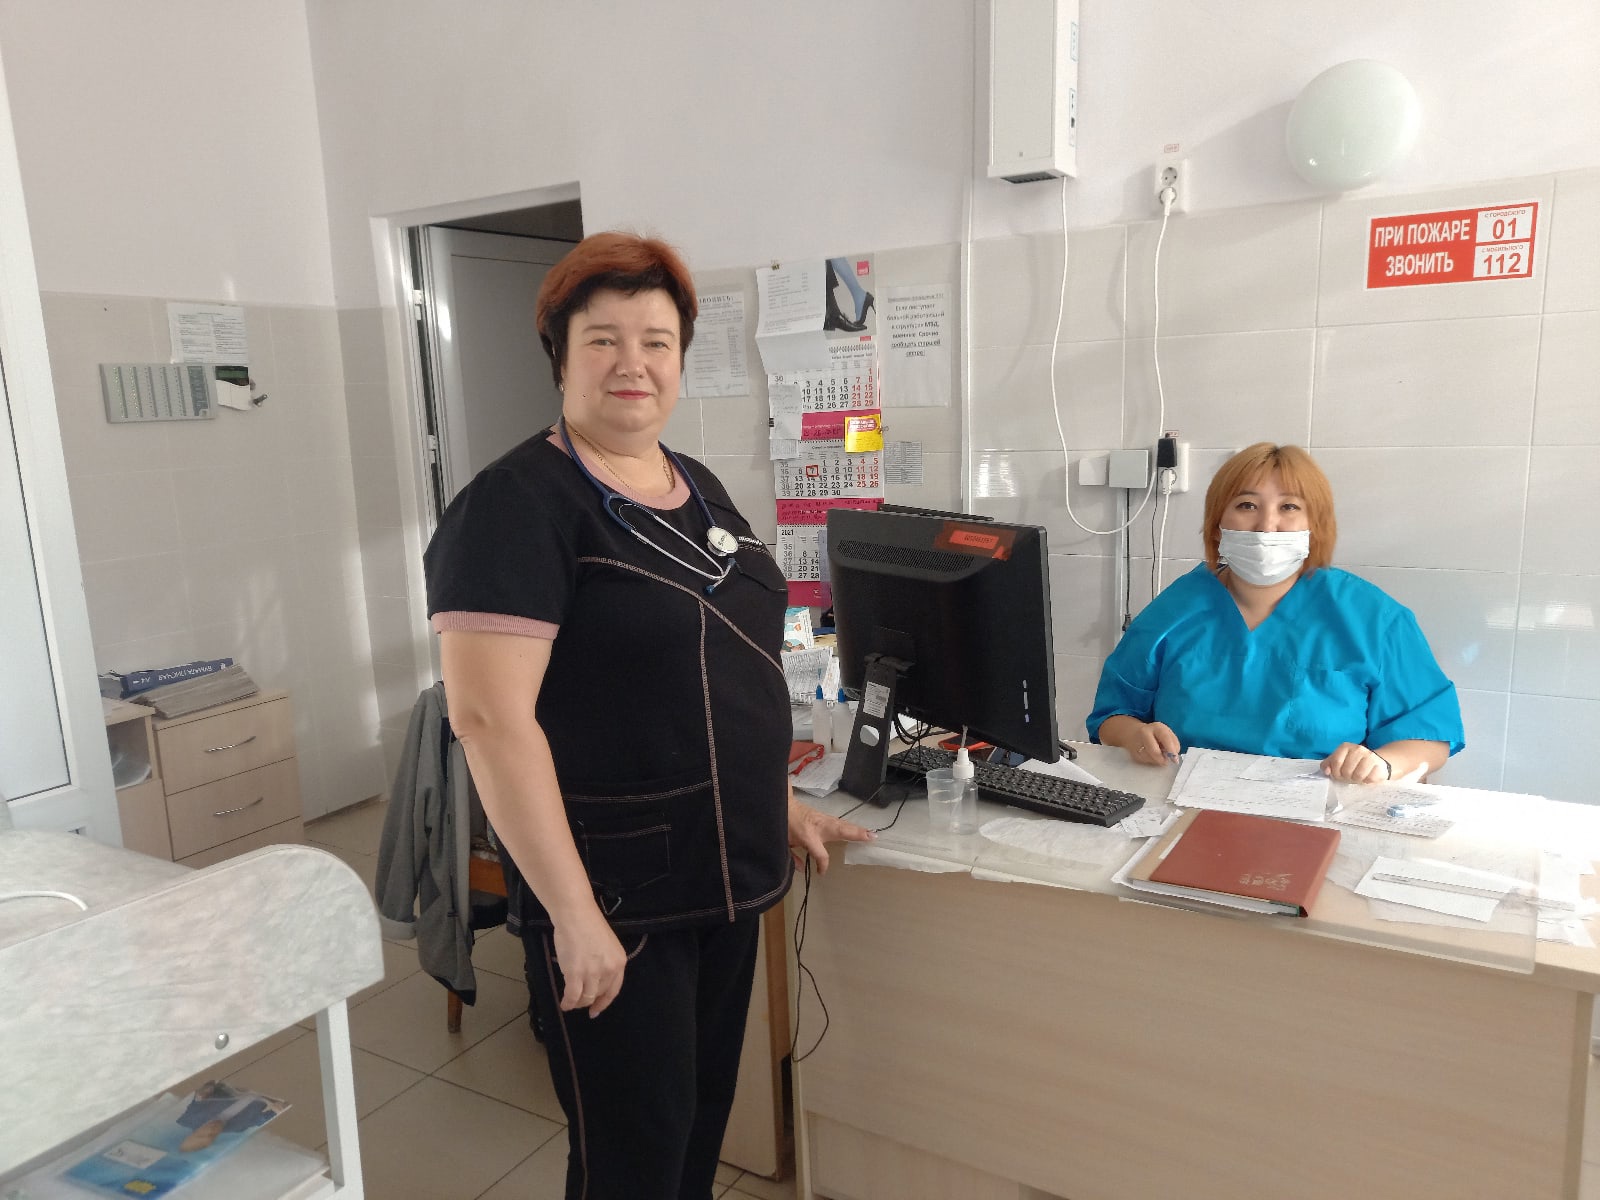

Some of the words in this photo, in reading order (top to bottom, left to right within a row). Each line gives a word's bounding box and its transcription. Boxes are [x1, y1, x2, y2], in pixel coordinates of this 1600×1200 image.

[1374, 226, 1404, 247] ПРИ
[1407, 219, 1470, 244] ПОЖАРЕ
[1493, 218, 1516, 239] 01
[1386, 252, 1454, 276] ЗВОНИТЬ
[1483, 253, 1521, 275] 112
